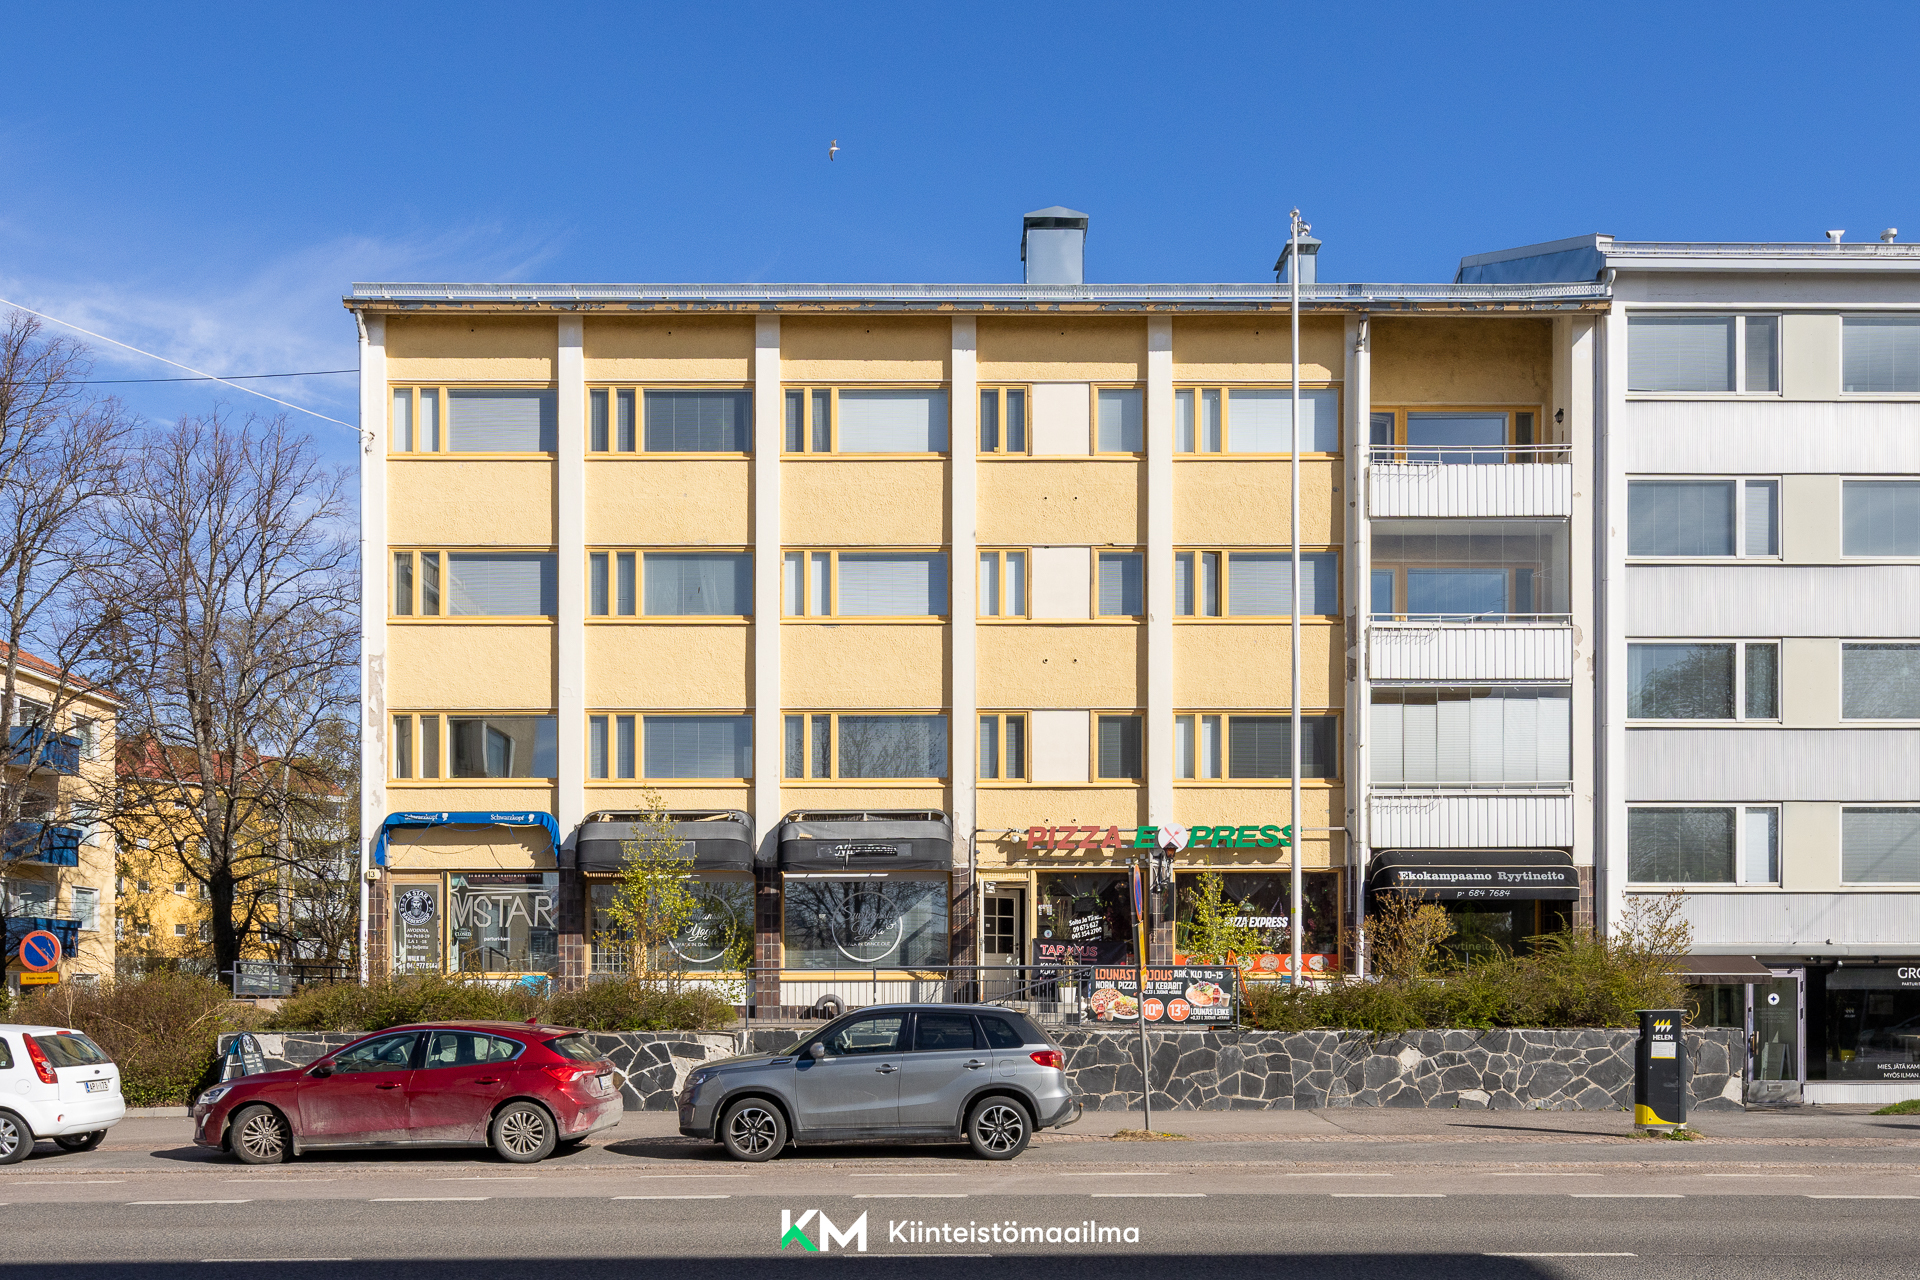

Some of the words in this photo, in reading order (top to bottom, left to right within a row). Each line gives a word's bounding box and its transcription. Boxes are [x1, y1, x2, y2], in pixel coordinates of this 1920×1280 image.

[491, 814, 525, 822] Schwarzkopf
[1026, 826, 1122, 849] PIZZA
[368, 870, 375, 878] 13
[1398, 871, 1492, 882] Ekokampaamo
[1497, 871, 1565, 882] Ryytineito
[1468, 889, 1486, 897] 684
[1489, 889, 1511, 897] 7684
[452, 895, 556, 928] MSTAR
[1249, 916, 1289, 928] EXPRESS
[685, 922, 718, 942] Yoga
[851, 920, 885, 940] Yoga
[1095, 968, 1173, 982] LOUNASTJOUS
[1190, 970, 1201, 979] KLO
[1203, 970, 1224, 980] 10-15
[1897, 967, 1920, 979] GR
[1117, 981, 1138, 990] PIZZA
[1155, 981, 1183, 990] KEBABIT
[1190, 1008, 1213, 1016] LOUNAS
[1893, 1062, 1906, 1070] JÄTÄ
[1883, 1071, 1900, 1079] MYÖS
